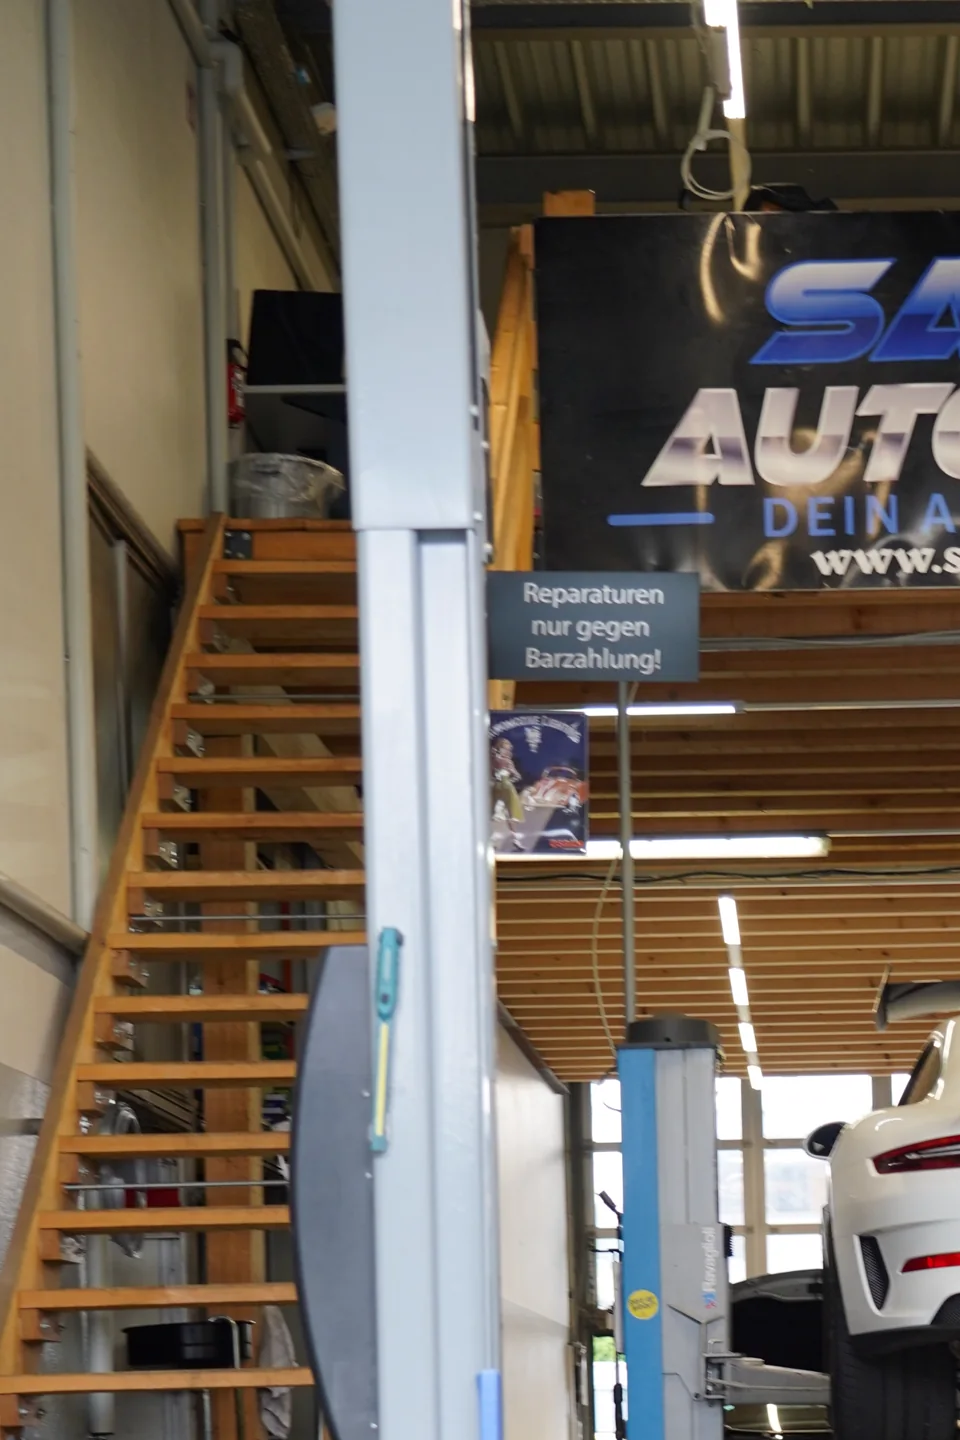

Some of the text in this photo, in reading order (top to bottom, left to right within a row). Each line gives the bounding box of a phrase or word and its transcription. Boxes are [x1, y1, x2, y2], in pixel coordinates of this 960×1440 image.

[763, 493, 899, 538] DEIN
[523, 581, 665, 609] Reparaturen
[531, 619, 650, 642] nur gegen
[525, 647, 662, 675] Barzahlung!
